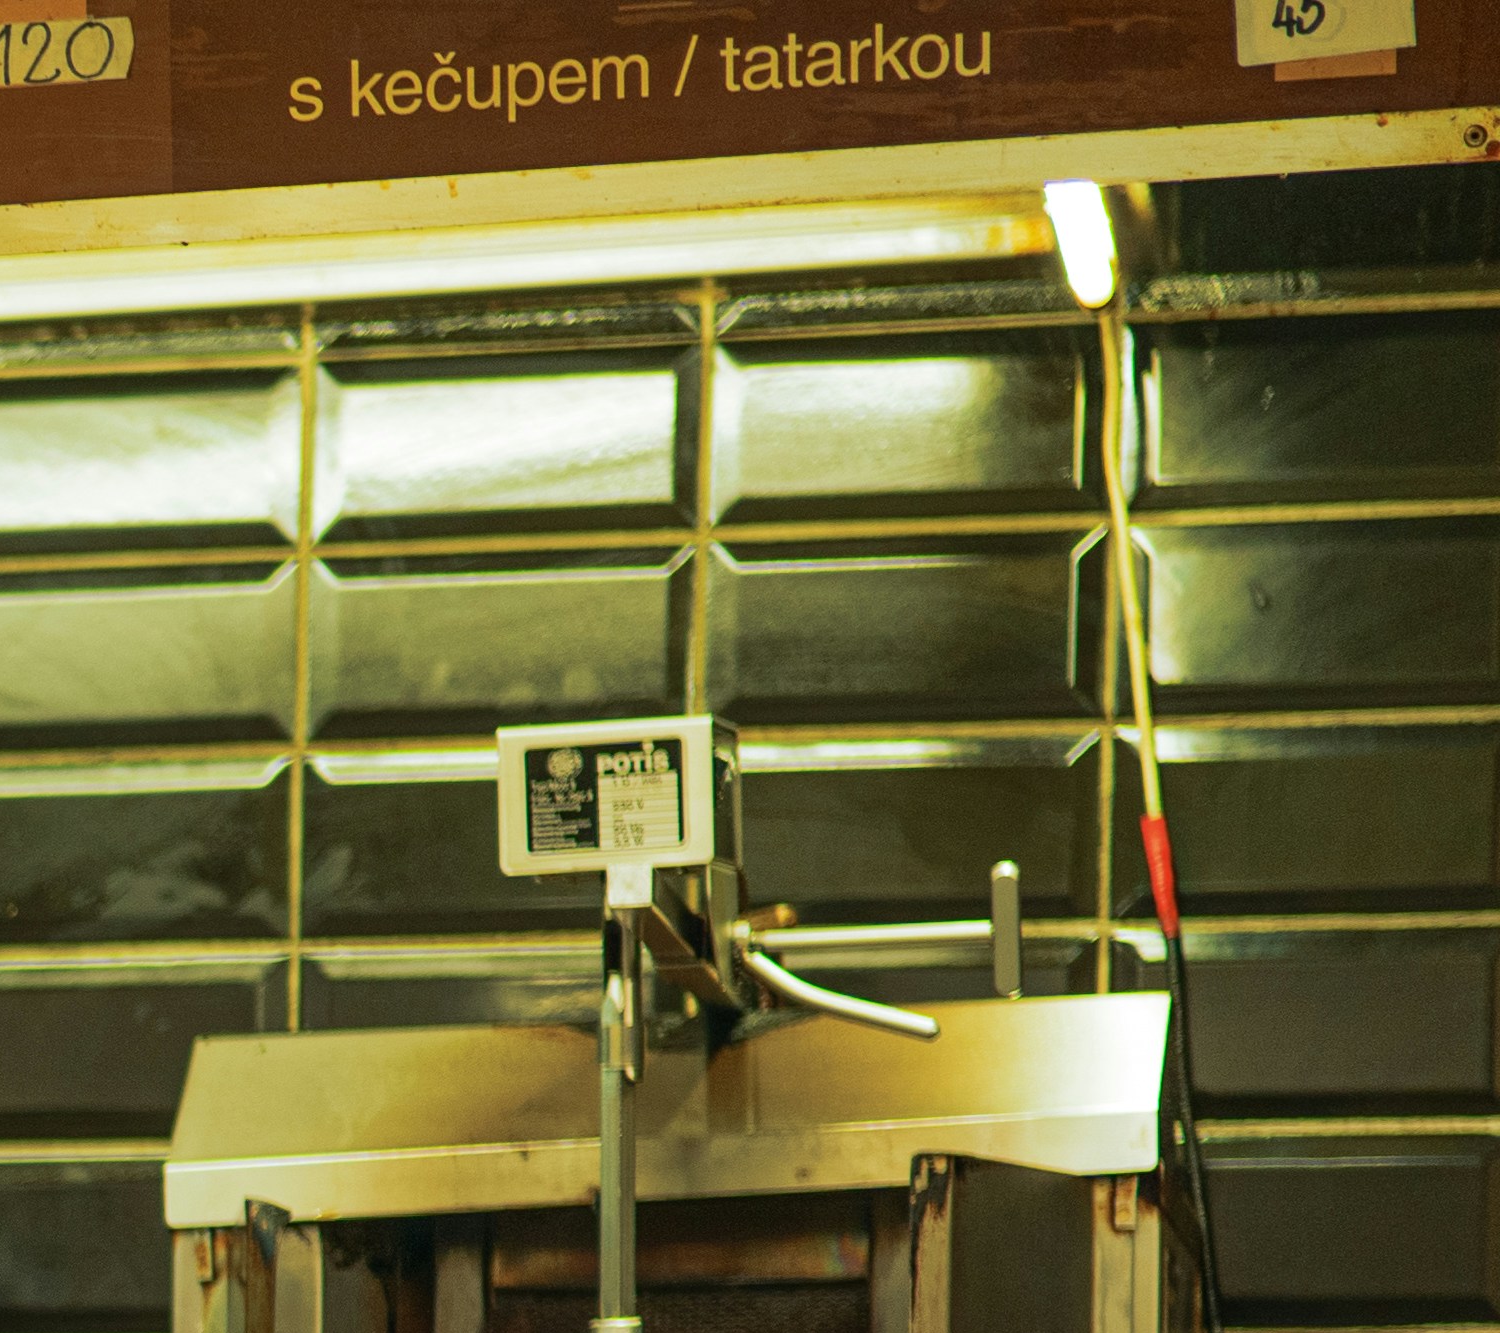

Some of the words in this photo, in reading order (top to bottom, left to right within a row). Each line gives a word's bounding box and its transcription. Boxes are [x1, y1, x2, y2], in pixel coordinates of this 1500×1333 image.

[288, 77, 323, 121] s
[350, 51, 649, 123] kečupem
[674, 34, 698, 97] /
[720, 23, 990, 92] tatarkou
